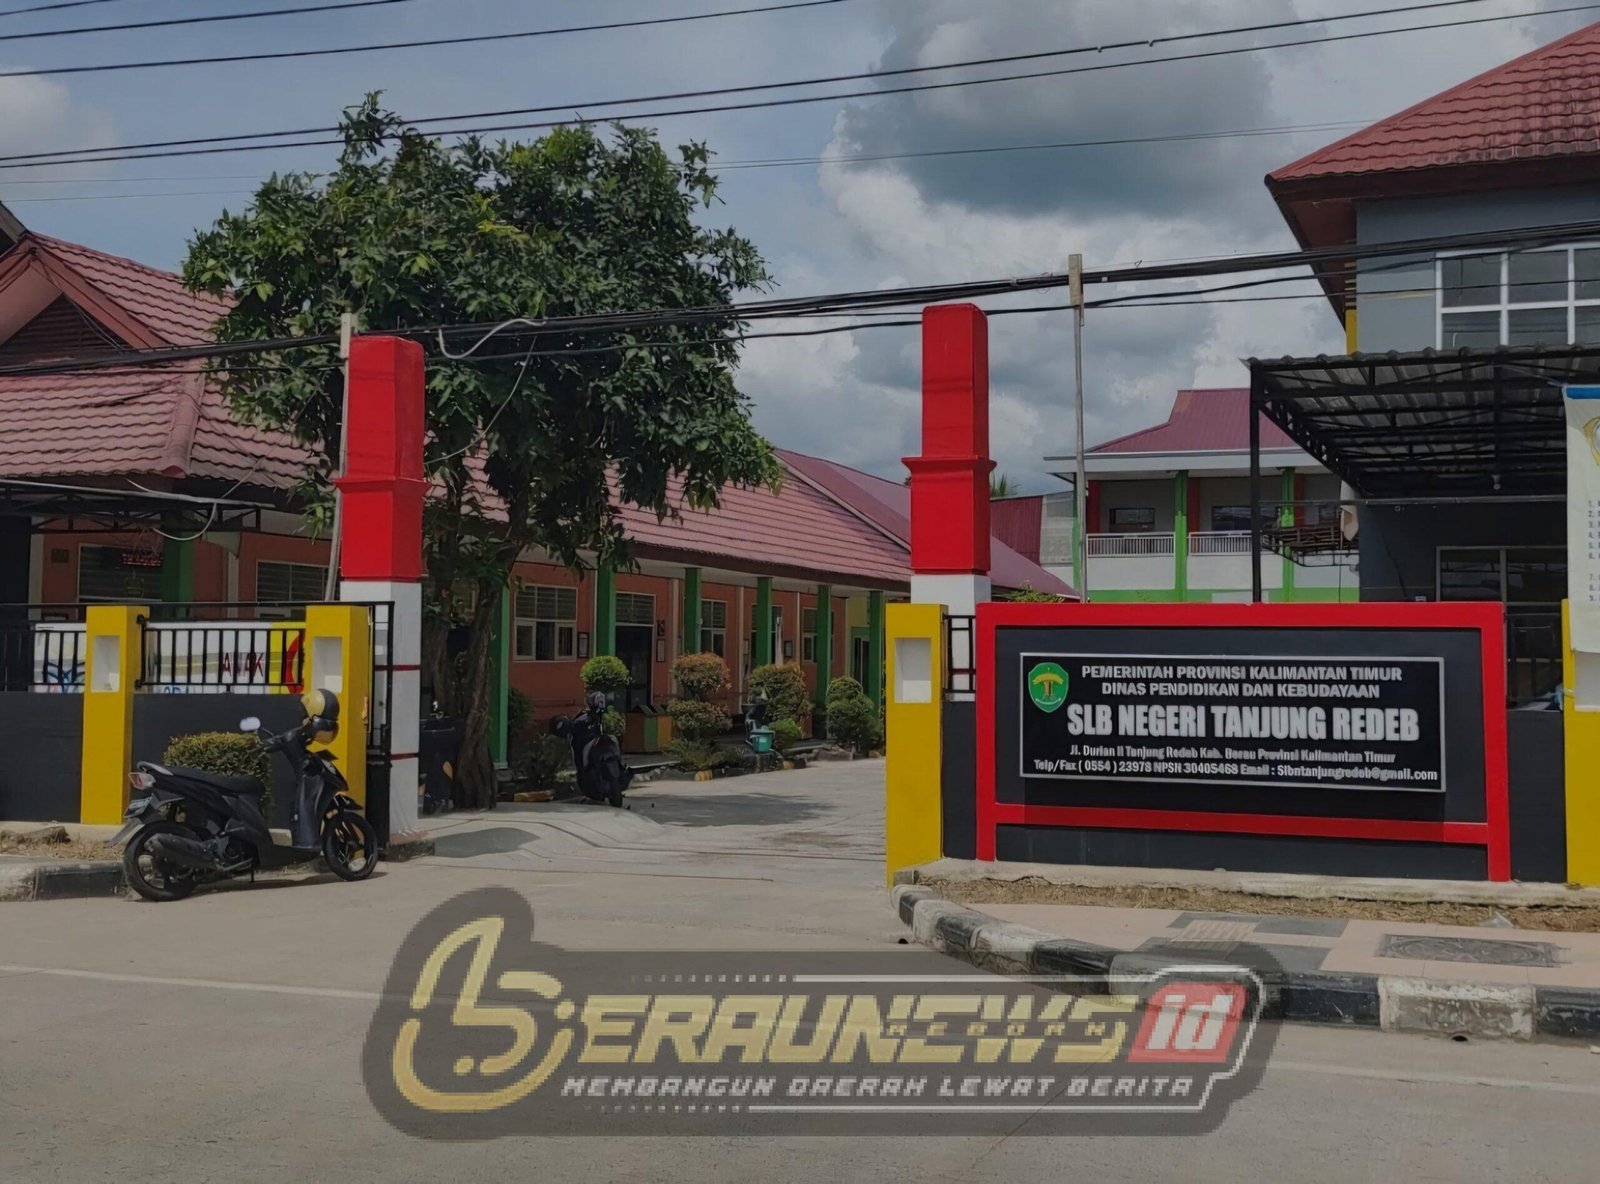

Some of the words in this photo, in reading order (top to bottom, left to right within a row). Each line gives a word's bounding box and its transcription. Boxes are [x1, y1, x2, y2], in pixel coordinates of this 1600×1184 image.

[1081, 665, 1174, 679] PEMERINTAH
[1176, 666, 1246, 680] PROVINSI
[1250, 666, 1347, 681] KALIMANTAN
[1350, 667, 1403, 681] TIMUR
[1101, 682, 1147, 696] DINAS
[1149, 682, 1239, 697] PENDIDIKAN
[1242, 683, 1274, 697] DAN
[1277, 684, 1380, 698] KEBUDAYAAN
[1066, 703, 1113, 736] SLB
[1118, 704, 1206, 738] NEGERI
[1210, 705, 1327, 740] TANJUNG
[1332, 707, 1420, 741] REDEB
[1083, 745, 1115, 757] Durian
[1125, 746, 1165, 760] Tanjung
[1257, 749, 1299, 761] Provinsi
[1300, 750, 1363, 763] Kalimantan
[1364, 751, 1397, 764] Timur
[1153, 762, 1182, 774] NPSN
